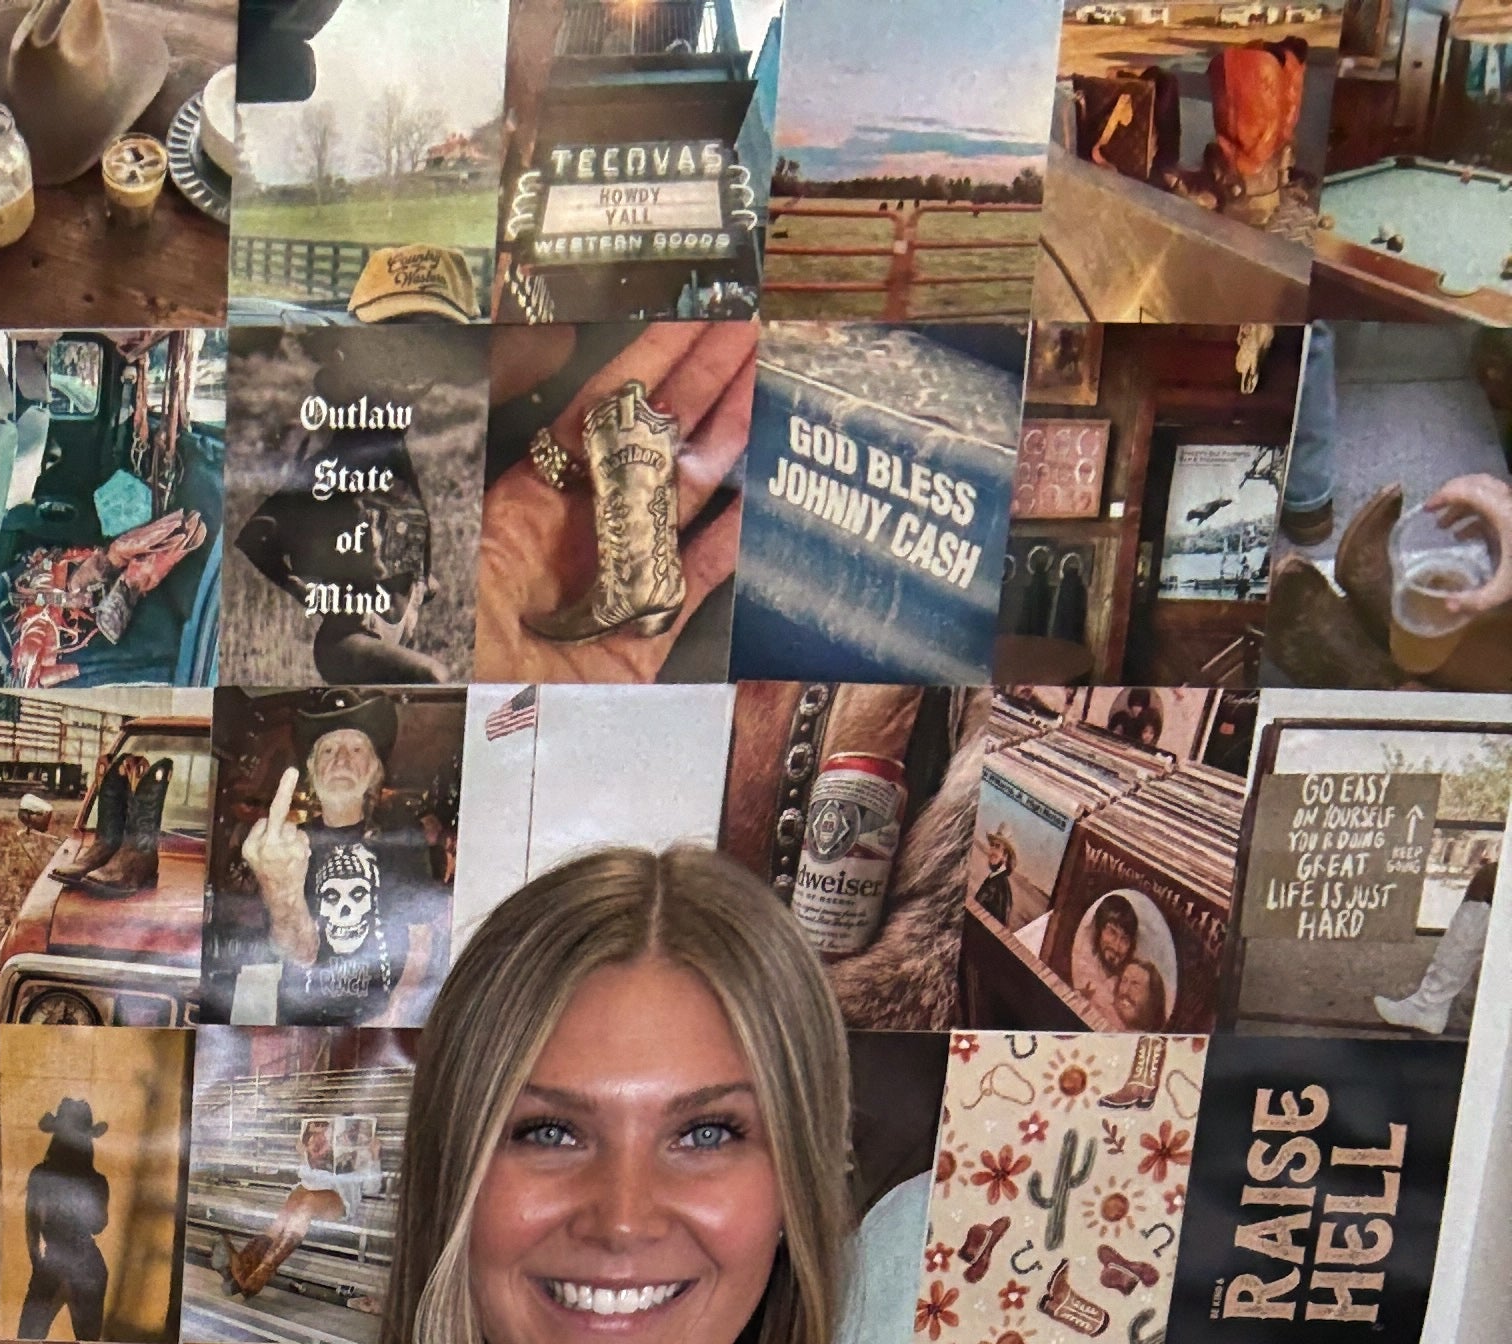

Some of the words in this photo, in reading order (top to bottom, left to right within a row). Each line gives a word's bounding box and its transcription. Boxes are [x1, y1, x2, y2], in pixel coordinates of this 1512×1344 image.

[550, 143, 723, 179] TECOVAS
[599, 187, 660, 206] HOWDY
[534, 234, 643, 254] WESTERN
[653, 232, 730, 251] GOODS
[300, 396, 413, 431] Outlaw
[312, 457, 394, 501] State
[789, 415, 858, 475] GOD
[867, 445, 977, 526] BLESS
[335, 521, 369, 554] of
[768, 457, 893, 543] JOHNNY
[890, 512, 982, 589] CASH
[304, 582, 391, 618] Mind
[1302, 773, 1334, 805] GO
[1340, 772, 1392, 805] EASY
[1323, 804, 1396, 829] YOURSELF
[1289, 829, 1319, 852] YOU
[1337, 830, 1386, 850] DOING
[1297, 852, 1370, 881] GREAT
[1266, 878, 1315, 911] LIFE
[1320, 881, 1345, 909] IS
[1345, 882, 1398, 910] JUST
[1297, 908, 1365, 941] HARD
[1222, 1084, 1330, 1320] RAISE
[1304, 1122, 1408, 1323] HELL
